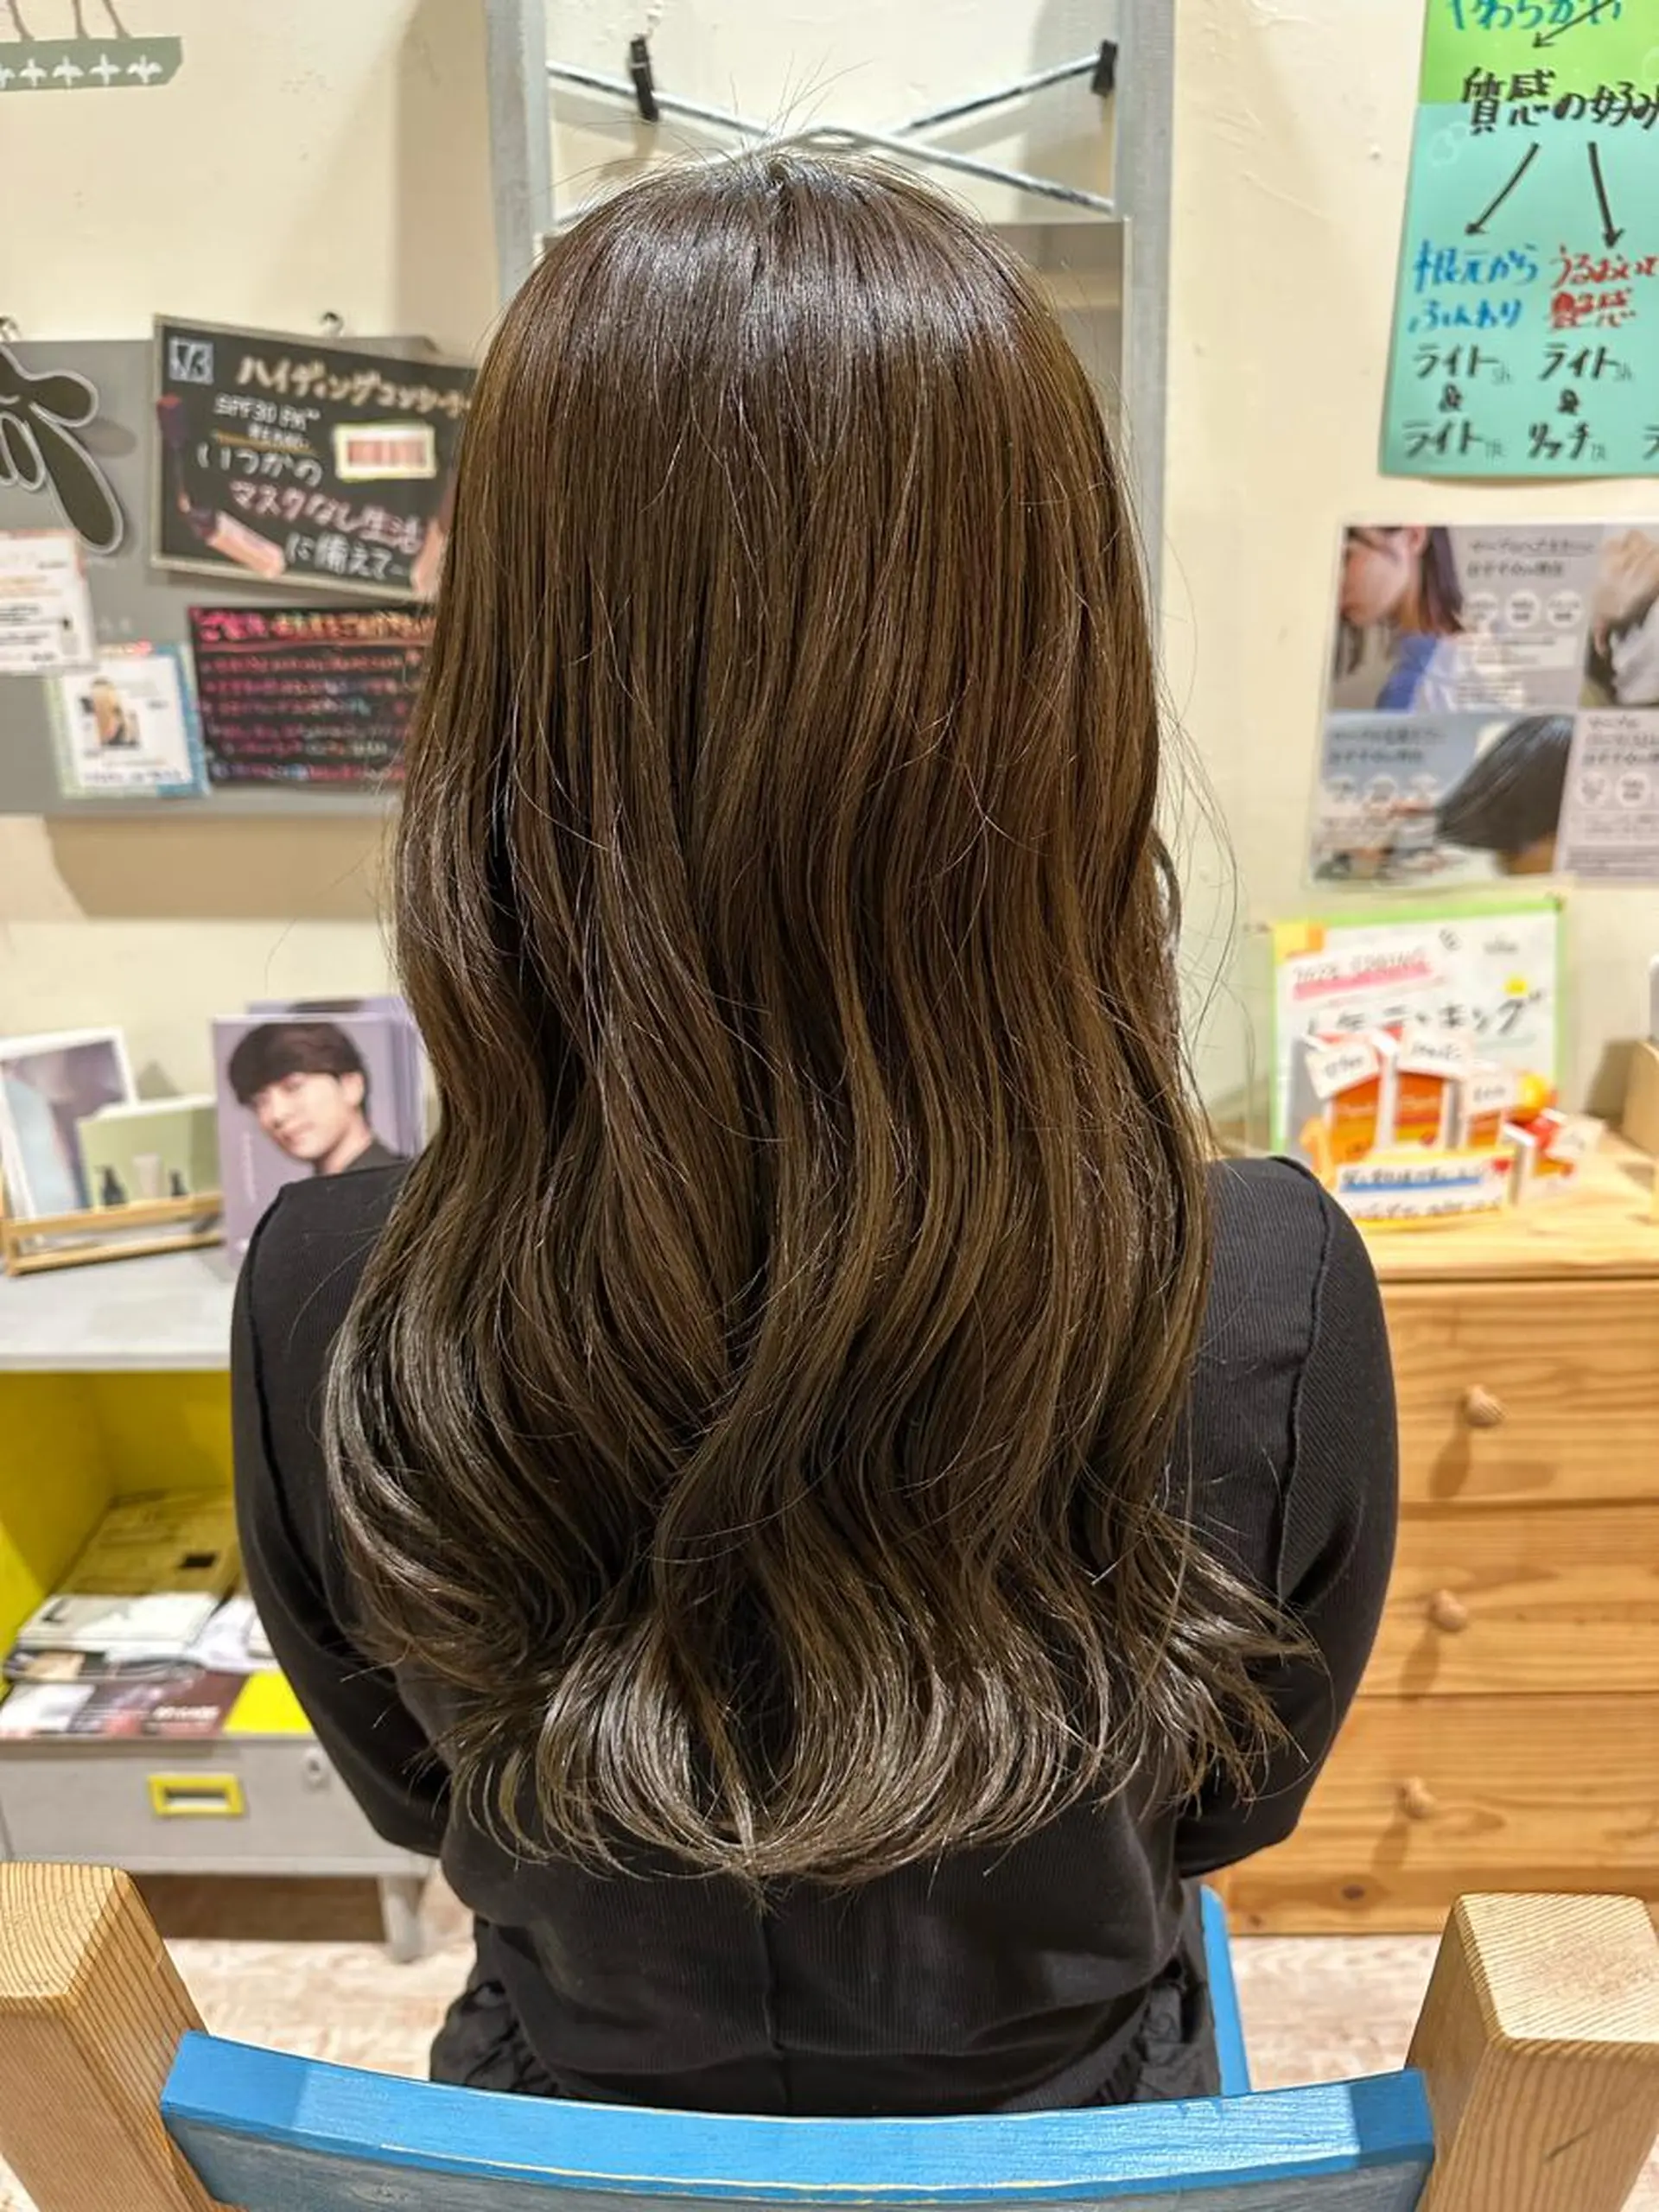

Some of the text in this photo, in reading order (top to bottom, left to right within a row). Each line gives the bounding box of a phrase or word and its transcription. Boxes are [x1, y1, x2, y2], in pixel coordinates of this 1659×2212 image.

[1413, 343, 1499, 379] ライト
[1538, 343, 1620, 381] ライト
[1402, 420, 1484, 459] ライト
[1528, 422, 1589, 460] リッチ
